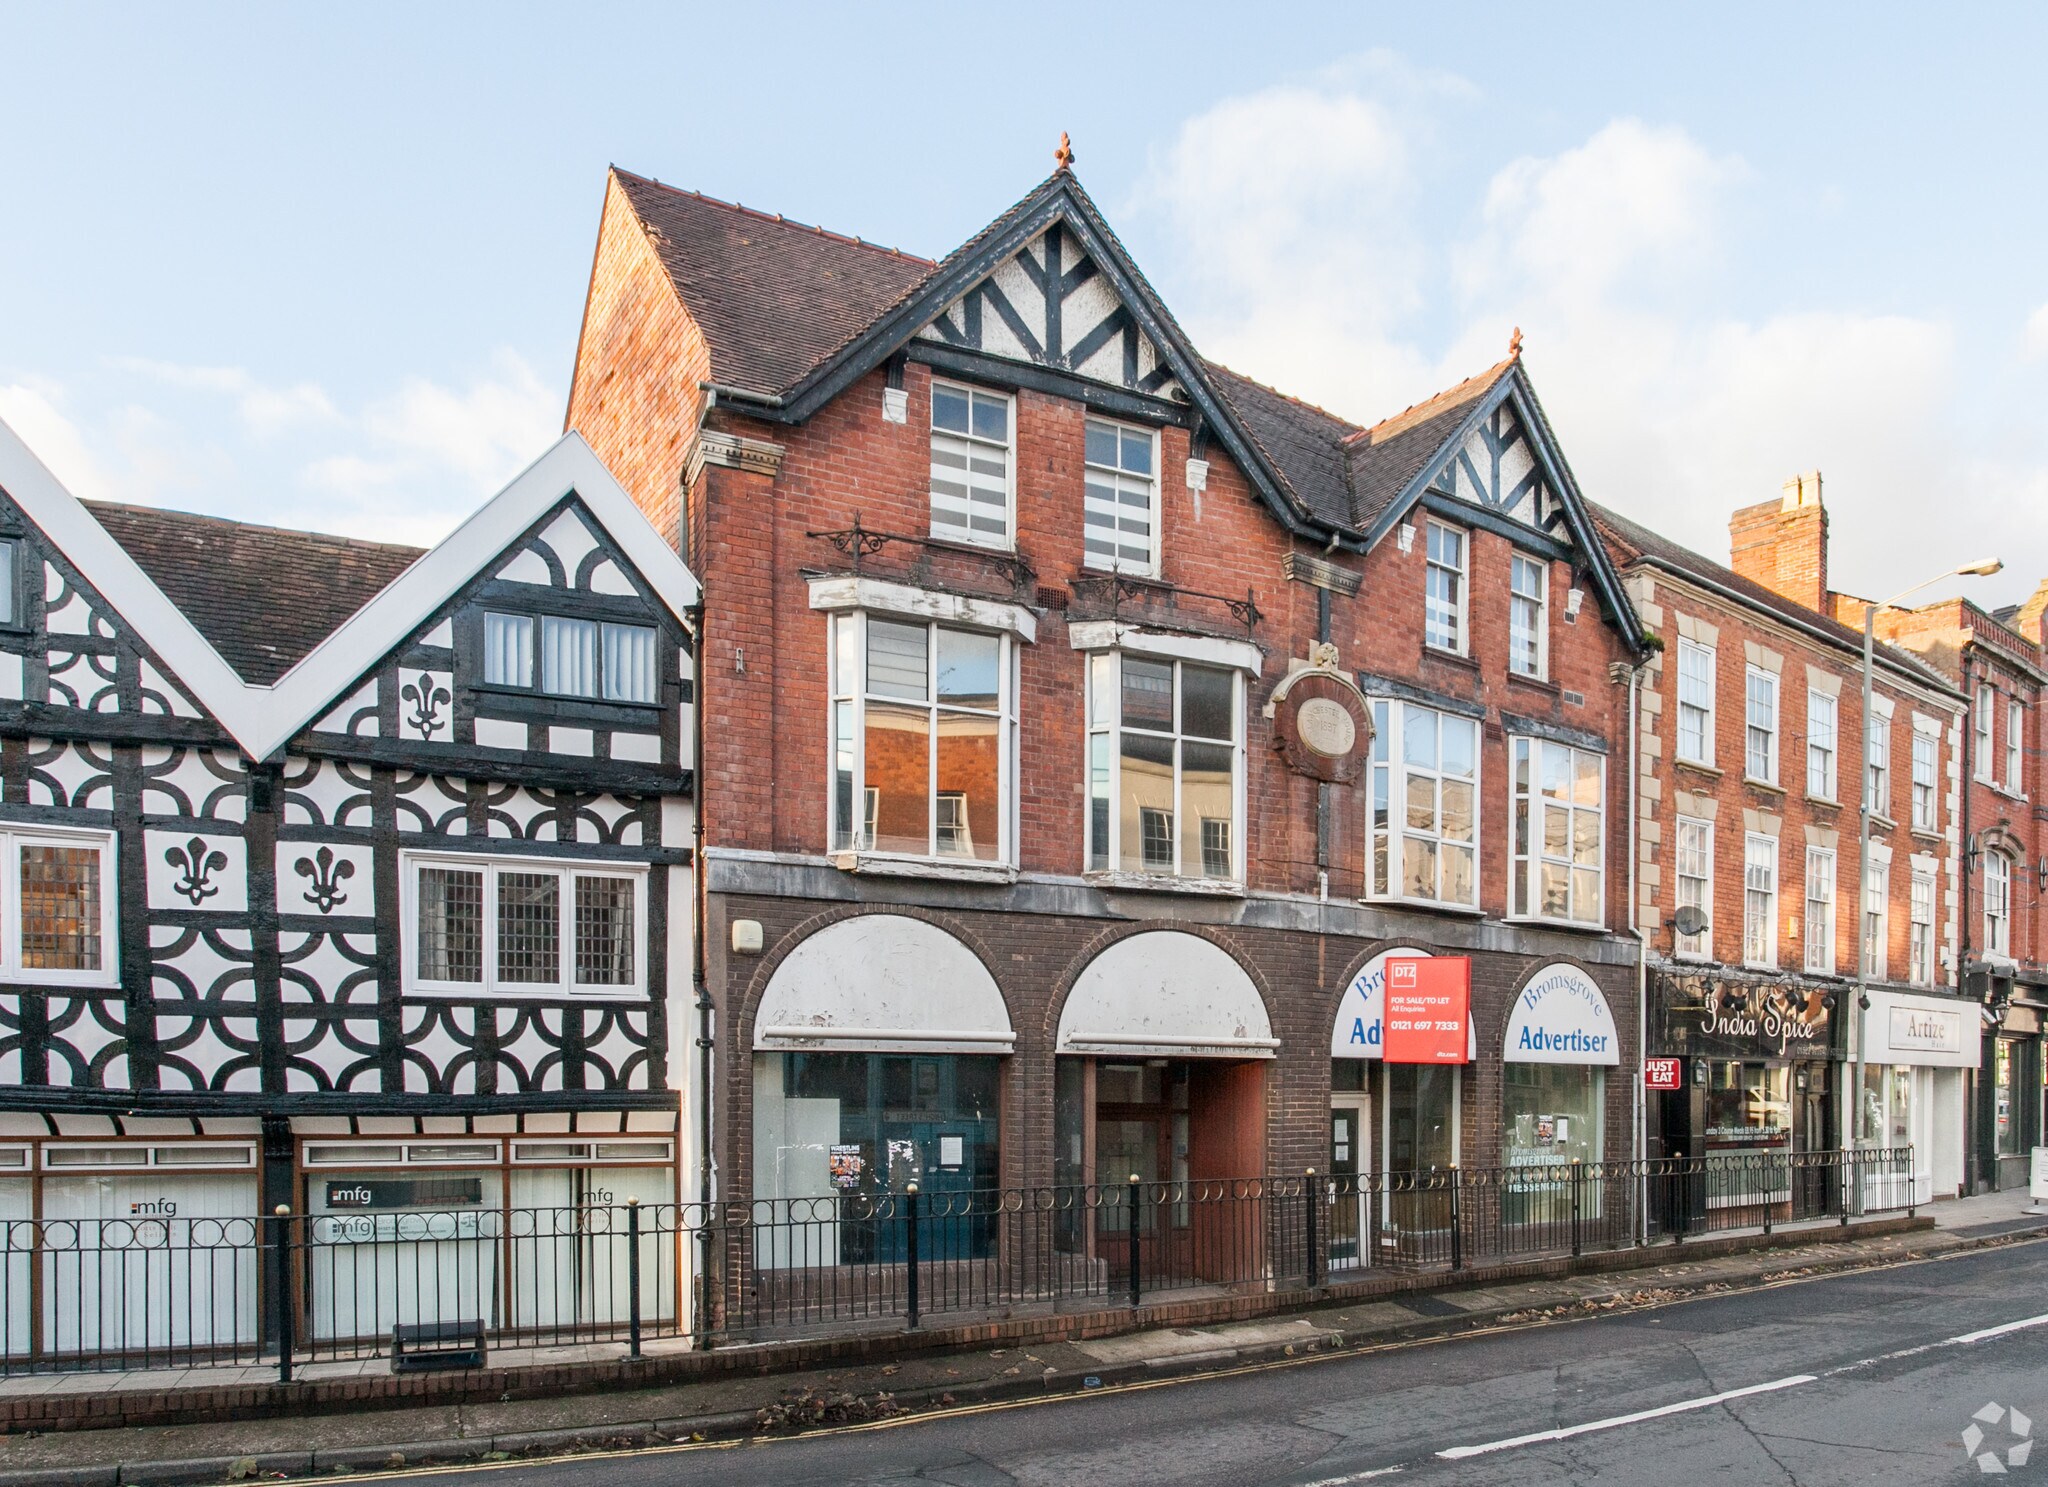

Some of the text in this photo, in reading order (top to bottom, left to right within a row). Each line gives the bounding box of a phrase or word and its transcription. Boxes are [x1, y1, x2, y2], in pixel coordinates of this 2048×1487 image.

[1395, 967, 1416, 977] DTZ
[1391, 997, 1450, 1005] FOR SALE/TO LET
[1523, 975, 1602, 1017] Bromsgrove
[1391, 1021, 1459, 1031] 0121 697 7333
[1701, 993, 1814, 1055] India Spice
[1907, 1014, 1945, 1039] Artize
[1519, 1026, 1607, 1052] Advertiser
[1646, 1061, 1675, 1072] JUST
[1652, 1072, 1675, 1082] EAT
[1510, 1154, 1566, 1167] ADVERTISER
[338, 1186, 371, 1204] mfg
[583, 1188, 613, 1205] mfg
[138, 1198, 177, 1217] mfg
[337, 1219, 371, 1236] mfg
